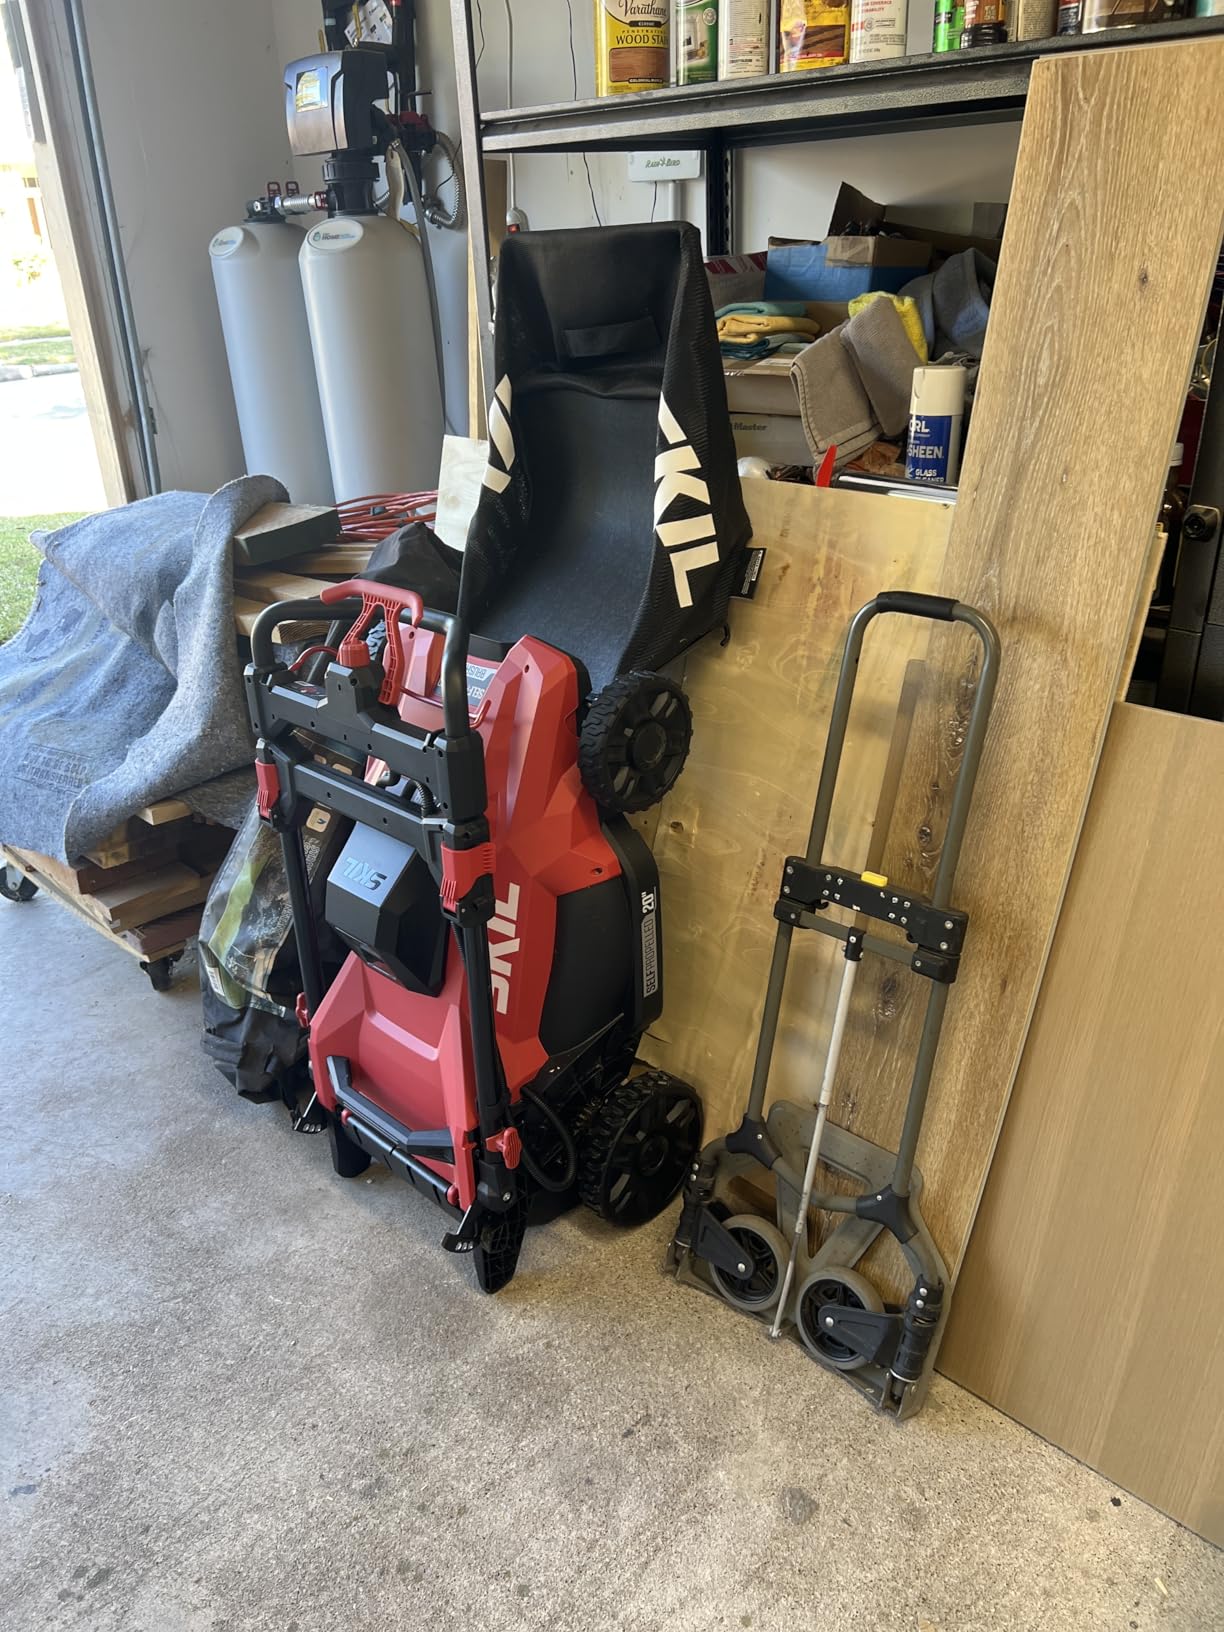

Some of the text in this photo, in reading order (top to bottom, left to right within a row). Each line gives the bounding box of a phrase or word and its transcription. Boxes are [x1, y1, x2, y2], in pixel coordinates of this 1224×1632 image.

[616, 34, 650, 46] WOOD
[915, 468, 938, 477] GLASS
[342, 856, 388, 891] SKIL
